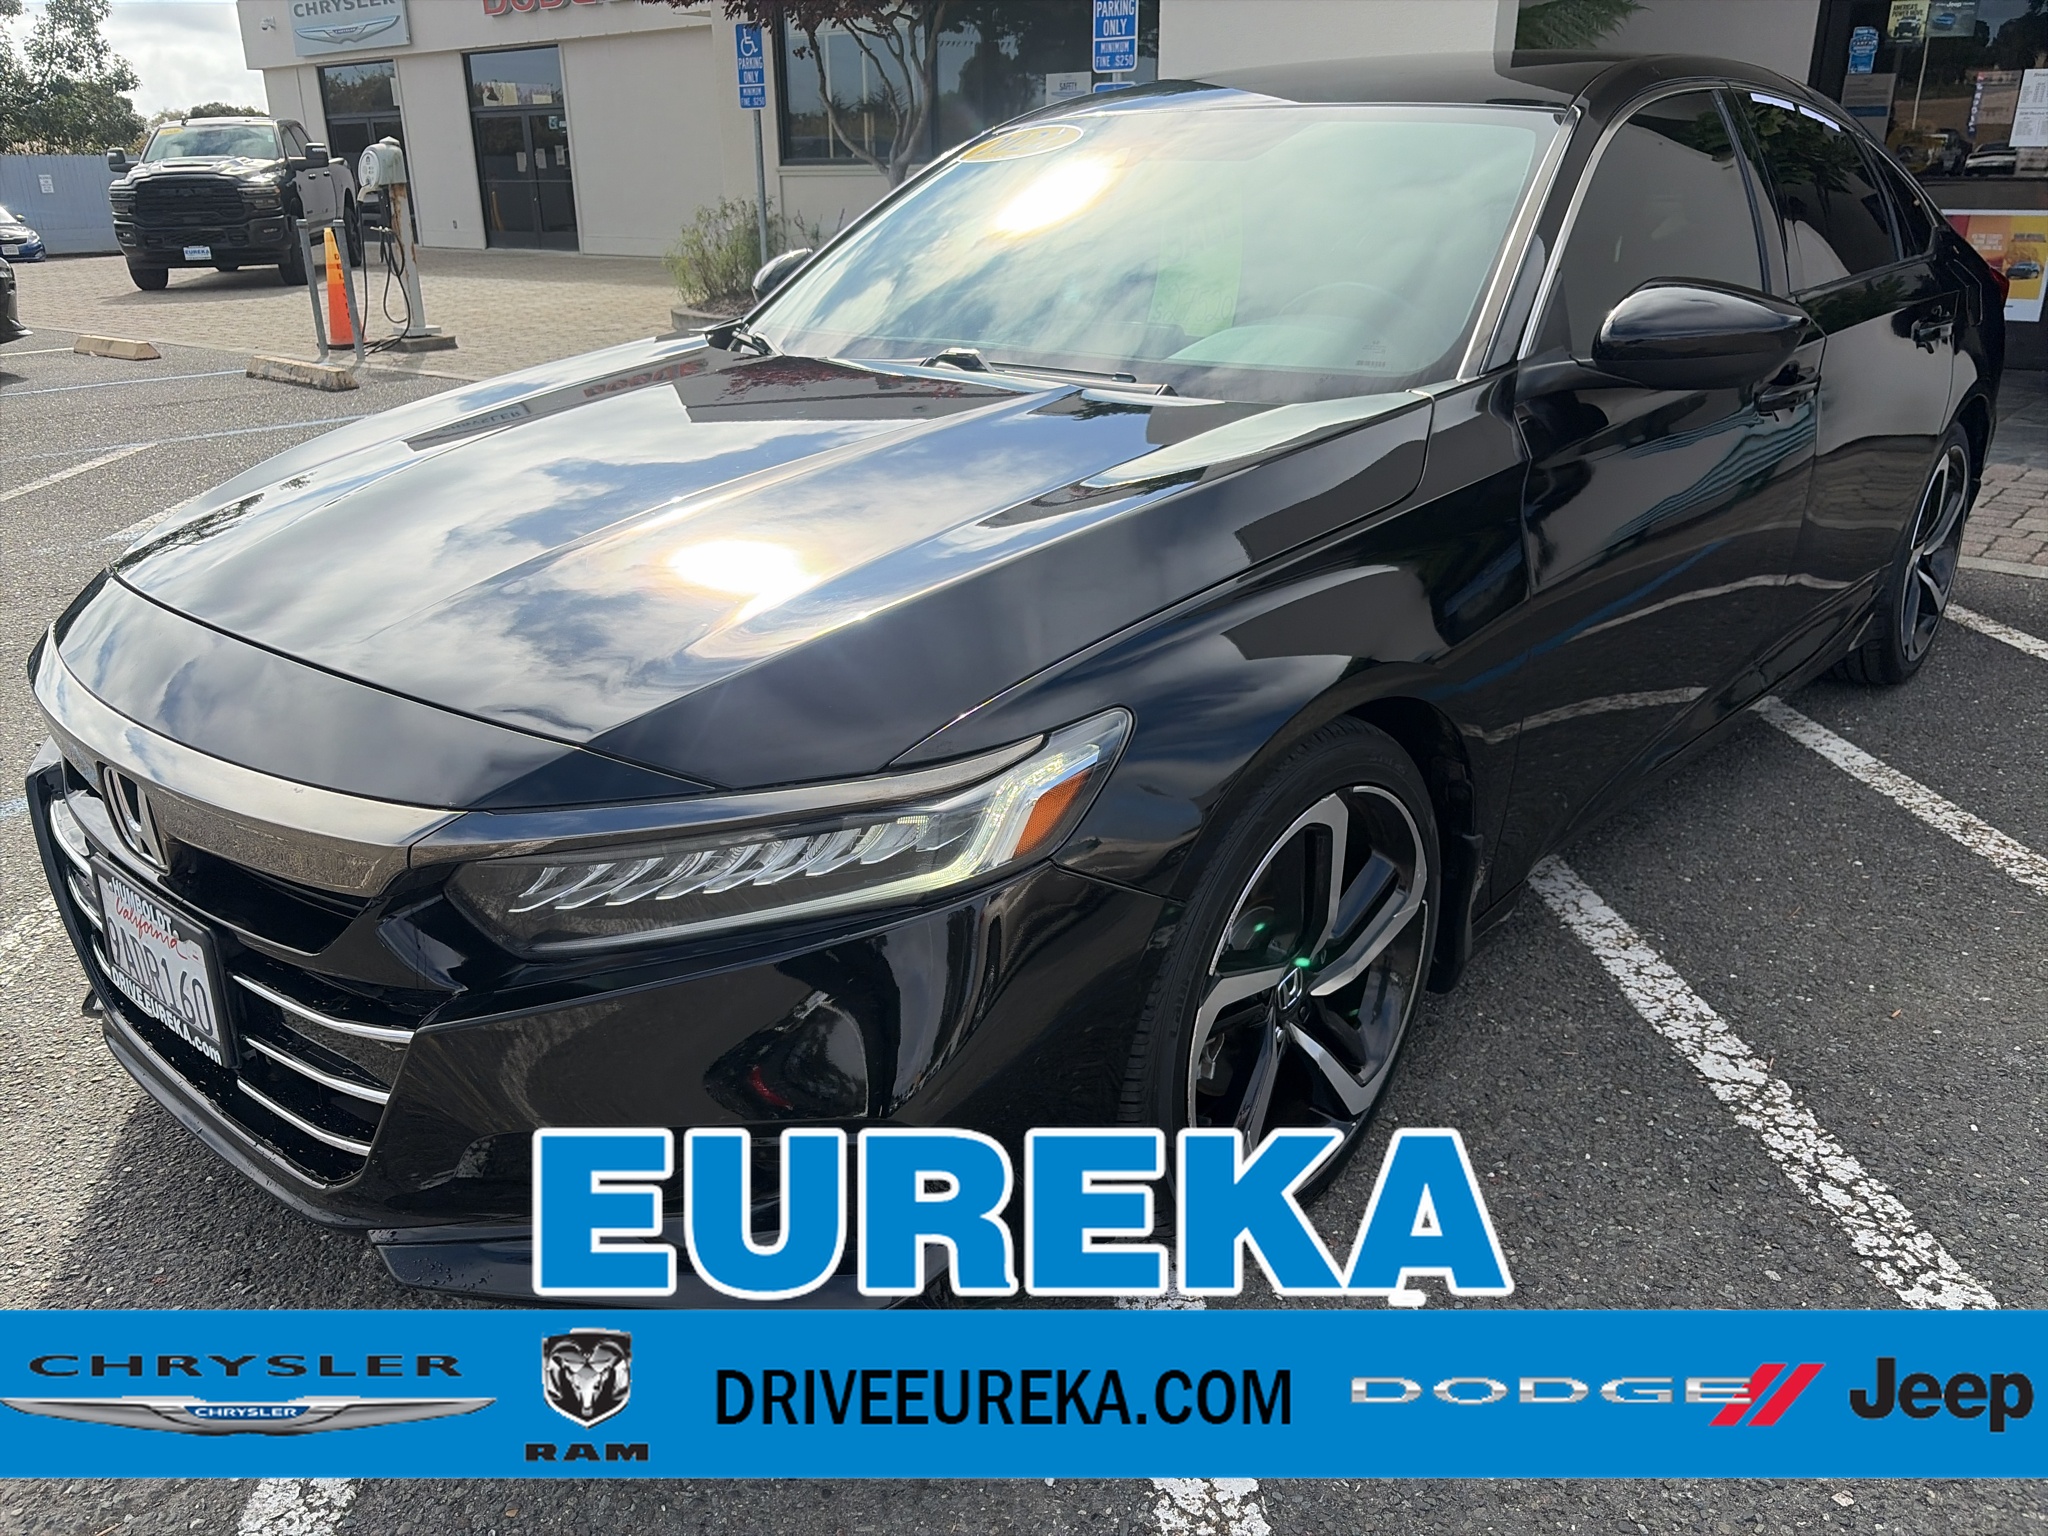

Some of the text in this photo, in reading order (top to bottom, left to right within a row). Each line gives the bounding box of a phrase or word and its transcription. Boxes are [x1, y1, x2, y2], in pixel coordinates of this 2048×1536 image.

[1097, 0, 1135, 18] PARKING
[1103, 19, 1127, 36] ONLY
[1100, 41, 1129, 54] MINIMUM
[738, 56, 763, 70] PARKING
[1095, 54, 1134, 67] FINE $250
[743, 71, 759, 84] ONLY
[111, 877, 173, 935] HUMBOLDT
[108, 917, 213, 1036] 9ADR160
